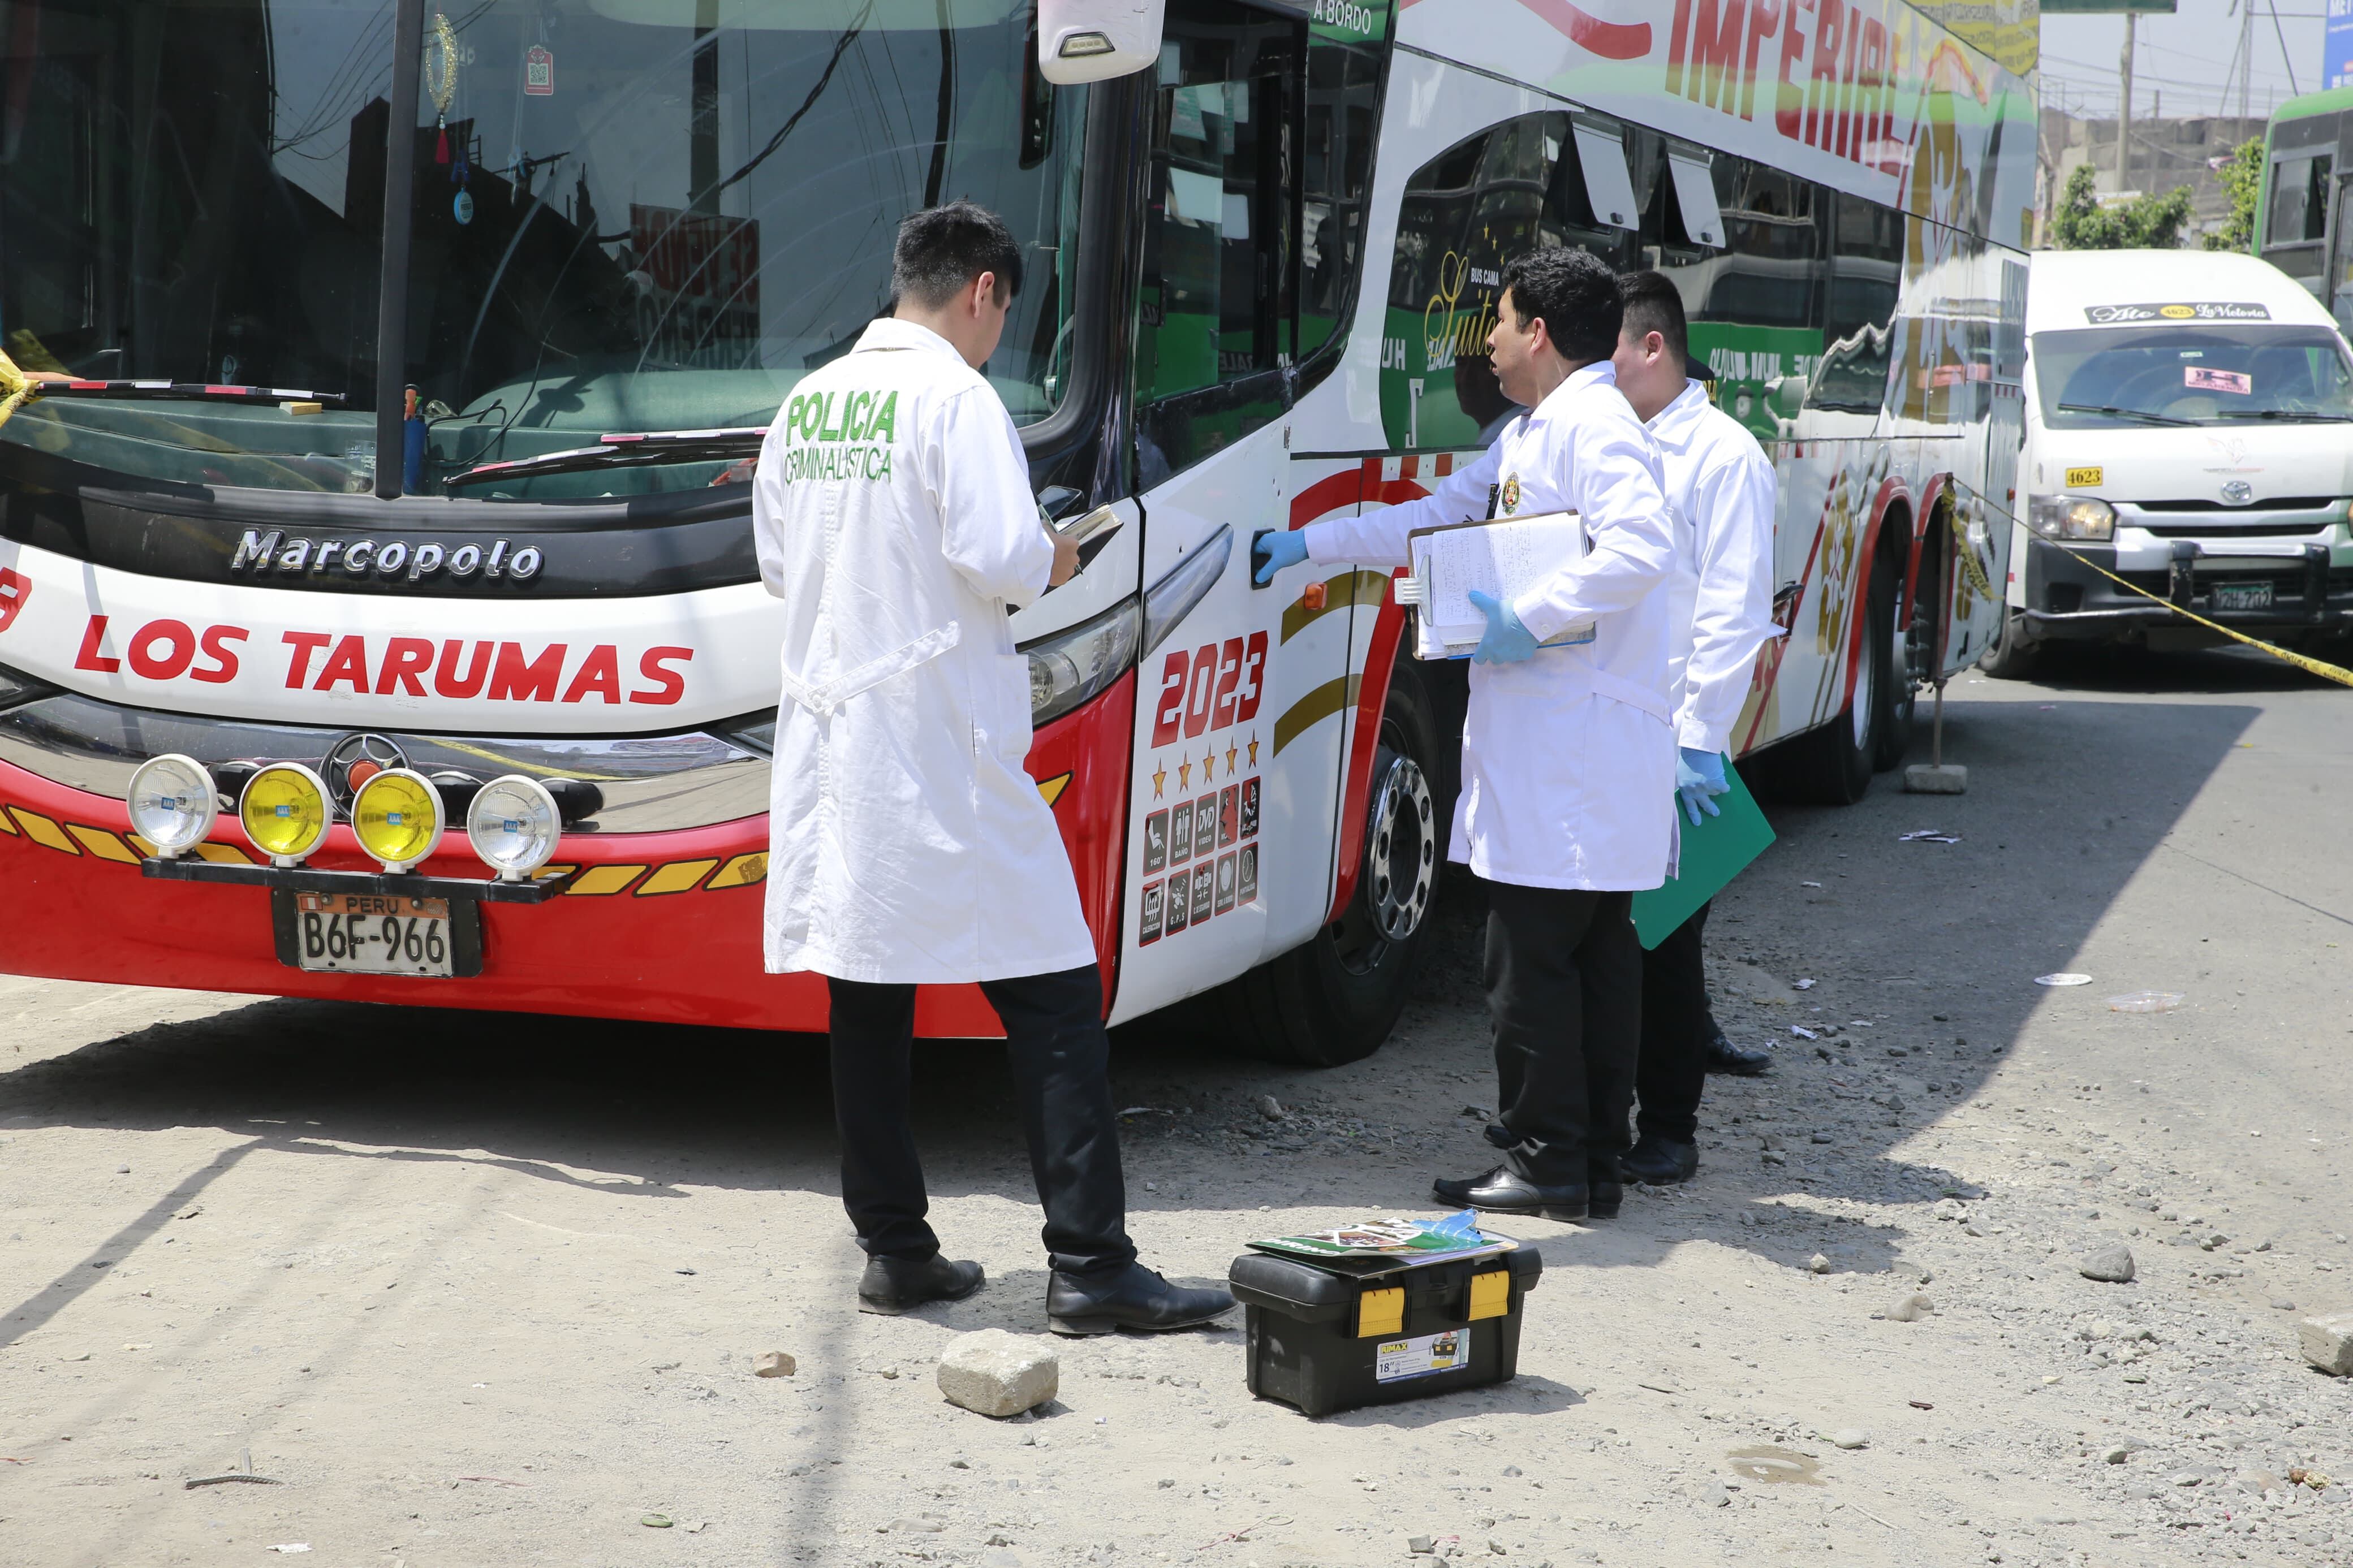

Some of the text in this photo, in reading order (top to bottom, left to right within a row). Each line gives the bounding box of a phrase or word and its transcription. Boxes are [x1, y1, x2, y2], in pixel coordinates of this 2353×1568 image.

[1313, 0, 1371, 34] A BORDO
[1665, 0, 1905, 178] IMPERIAL
[1471, 267, 1499, 287] BUS CAMA
[785, 447, 891, 485] CRIMINALISTICA
[2067, 469, 2100, 484] 4623
[231, 528, 544, 582] Marcopolo
[75, 615, 694, 705] LOS TARUMAS
[1150, 630, 1269, 749] 2023
[1198, 805, 1215, 833] DVD
[1175, 848, 1188, 858] BAÑO
[1199, 835, 1212, 846] VIDEO
[345, 896, 399, 914] PERU
[304, 912, 445, 963] B6F-966
